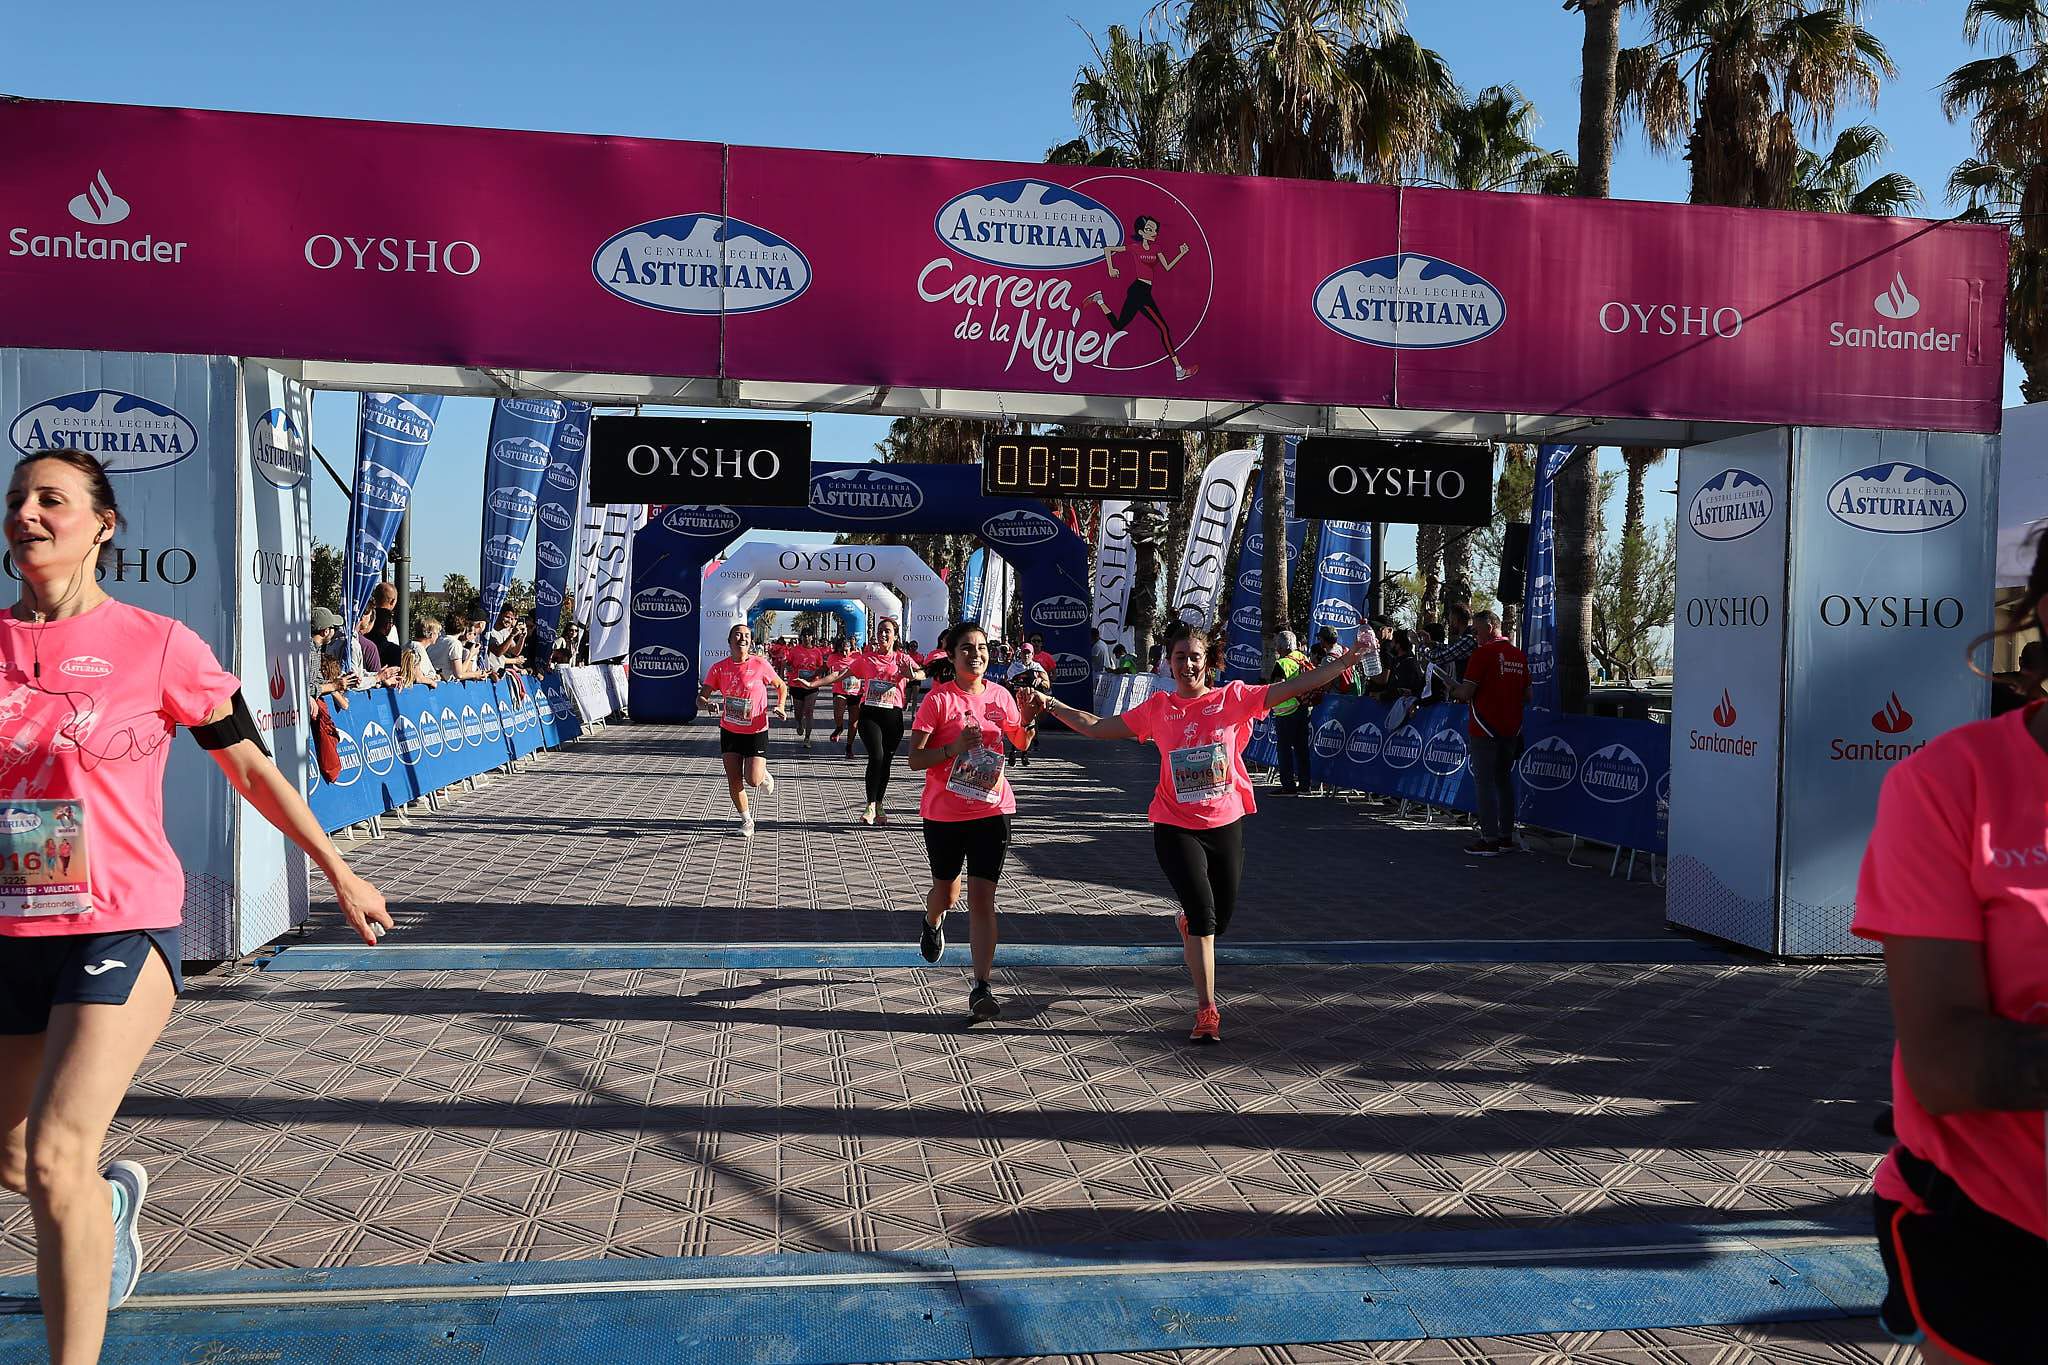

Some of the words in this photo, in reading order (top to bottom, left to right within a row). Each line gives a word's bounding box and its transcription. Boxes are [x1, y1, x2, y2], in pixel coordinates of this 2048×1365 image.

[949, 207, 1108, 250] ASTURIANA
[980, 207, 1038, 220] CENTRAL
[1045, 210, 1104, 223] LECHERA
[8, 227, 188, 264] Santander
[303, 234, 481, 276] OYSHO
[643, 246, 713, 258] CENTRAL
[609, 247, 795, 291] ASTURIANA
[917, 257, 1071, 311] Carrera
[1358, 284, 1418, 295] CENTRAL
[1425, 287, 1485, 298] LECHERA
[1327, 285, 1491, 327] ASTURIANA
[1599, 301, 1743, 338] OYSHO
[954, 309, 983, 339] de
[989, 309, 1010, 342] la
[1004, 307, 1129, 383] Mujer
[1829, 322, 1961, 352] Santander
[24, 418, 184, 454] ASTURIANA
[53, 417, 113, 427] CENTRAL
[119, 420, 178, 429] LECHERA
[627, 444, 780, 480] OYSHO
[998, 445, 1169, 490] 00:38:35
[810, 482, 914, 508] ASTURIANA
[828, 482, 868, 490] CENTRAL
[1327, 464, 1466, 499] OYSHO
[1858, 486, 1903, 495] CENTRAL
[1905, 487, 1951, 496] LECHERA
[1694, 499, 1766, 526] ASTURIANA
[1836, 487, 1956, 518] ASTURIANA
[667, 513, 735, 529] ASTURIANA
[988, 523, 1054, 537] ASTURIANA
[253, 549, 304, 588] OYSHO
[720, 571, 750, 579] OYSHO
[778, 550, 876, 573] OYSHO
[902, 574, 932, 582] OYSHO
[634, 597, 688, 613] ASTURIANA
[705, 610, 734, 618] OYSHO
[1035, 607, 1086, 620] ASTURIANA
[1687, 595, 1769, 628] OYSHO
[1819, 595, 1965, 629] OYSHO
[633, 656, 686, 671] ASTURIANA
[1689, 730, 1758, 757] Santander
[1830, 737, 1926, 761] Santan
[1522, 753, 1572, 780] ASTURIANA
[1584, 761, 1640, 792] ASTURIANA
[11, 886, 37, 895] MUJER
[43, 884, 81, 894] VALENCIA
[32, 900, 75, 909] Santander
